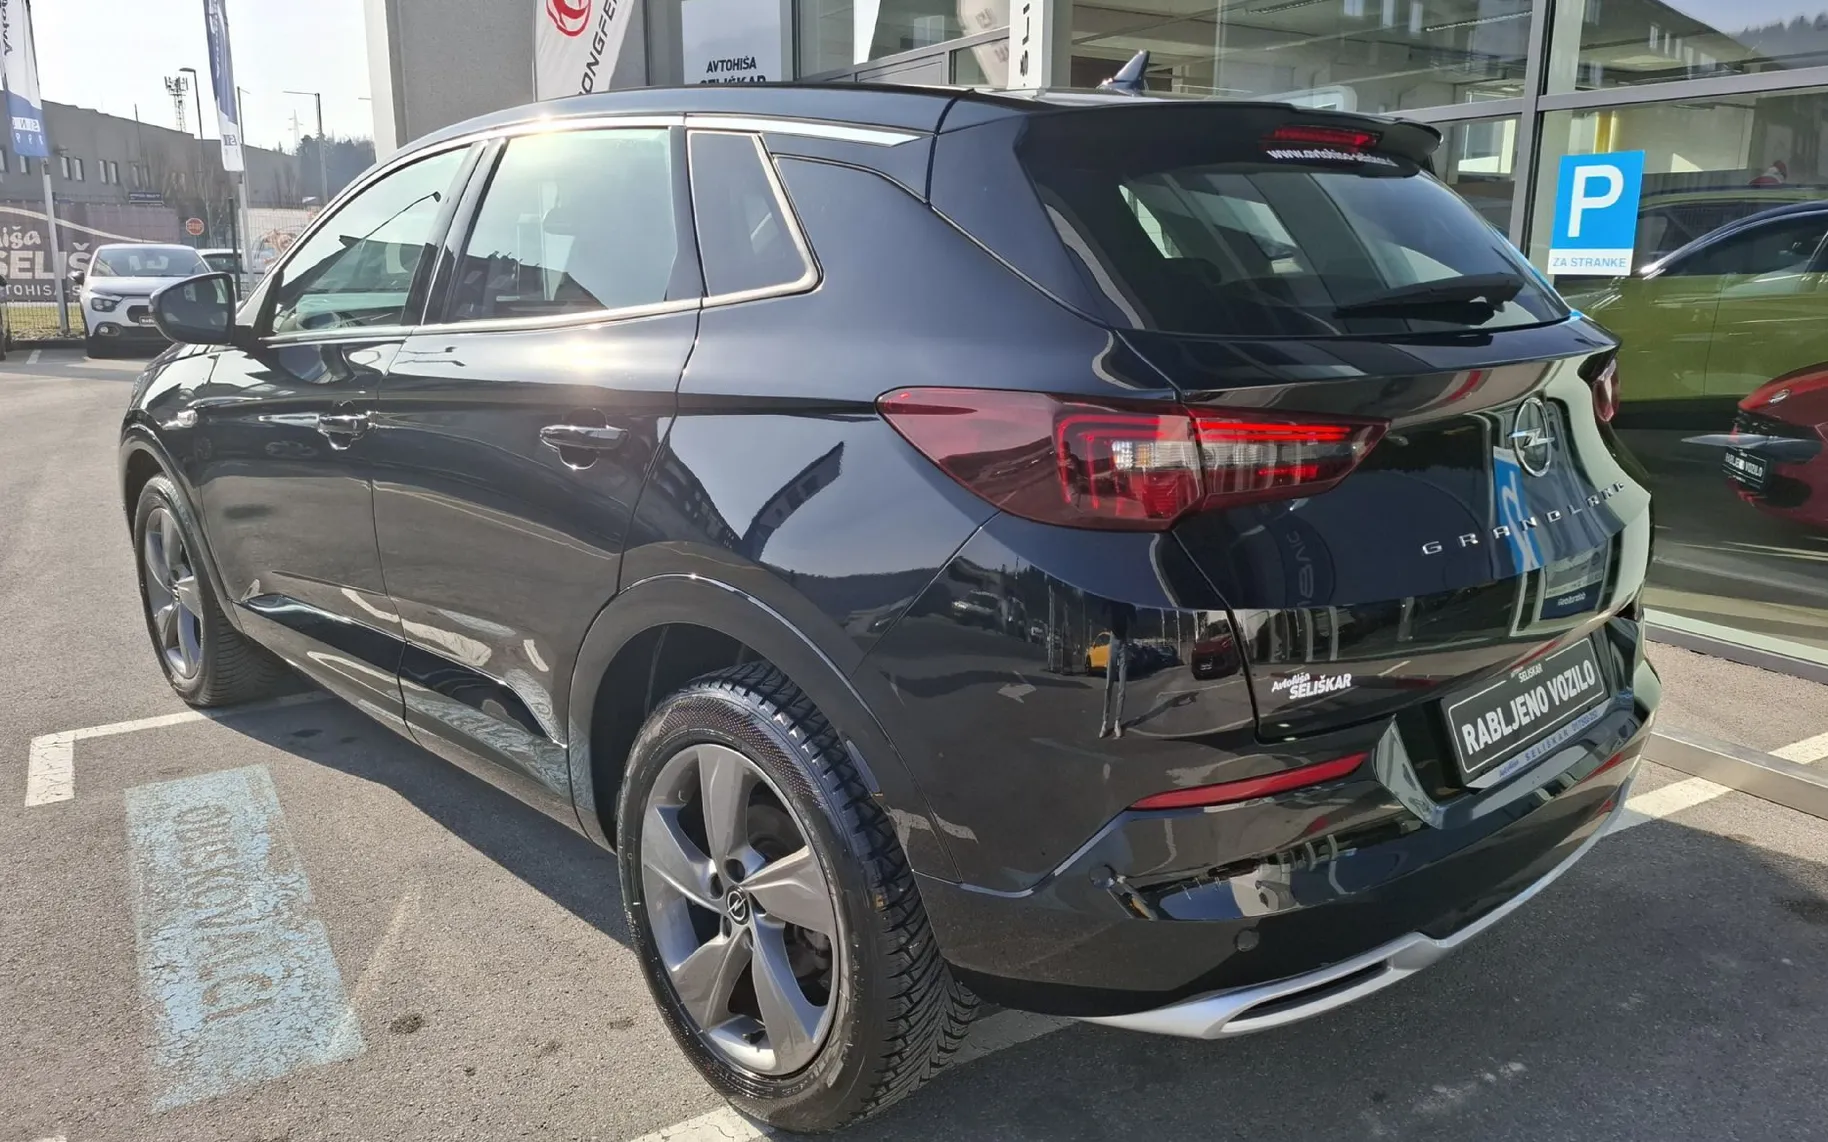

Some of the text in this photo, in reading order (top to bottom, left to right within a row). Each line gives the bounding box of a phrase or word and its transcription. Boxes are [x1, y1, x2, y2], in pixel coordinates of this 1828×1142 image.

[578, 0, 619, 94] ONGFE
[706, 56, 757, 73] AVTOHIŠA
[1567, 164, 1624, 238] P
[1552, 257, 1627, 268] ZA STRANKE
[1422, 481, 1624, 555] GRANDLAND
[1289, 673, 1352, 700] SELIŠKAR
[1461, 660, 1596, 755] RABLJENO VOZILO
